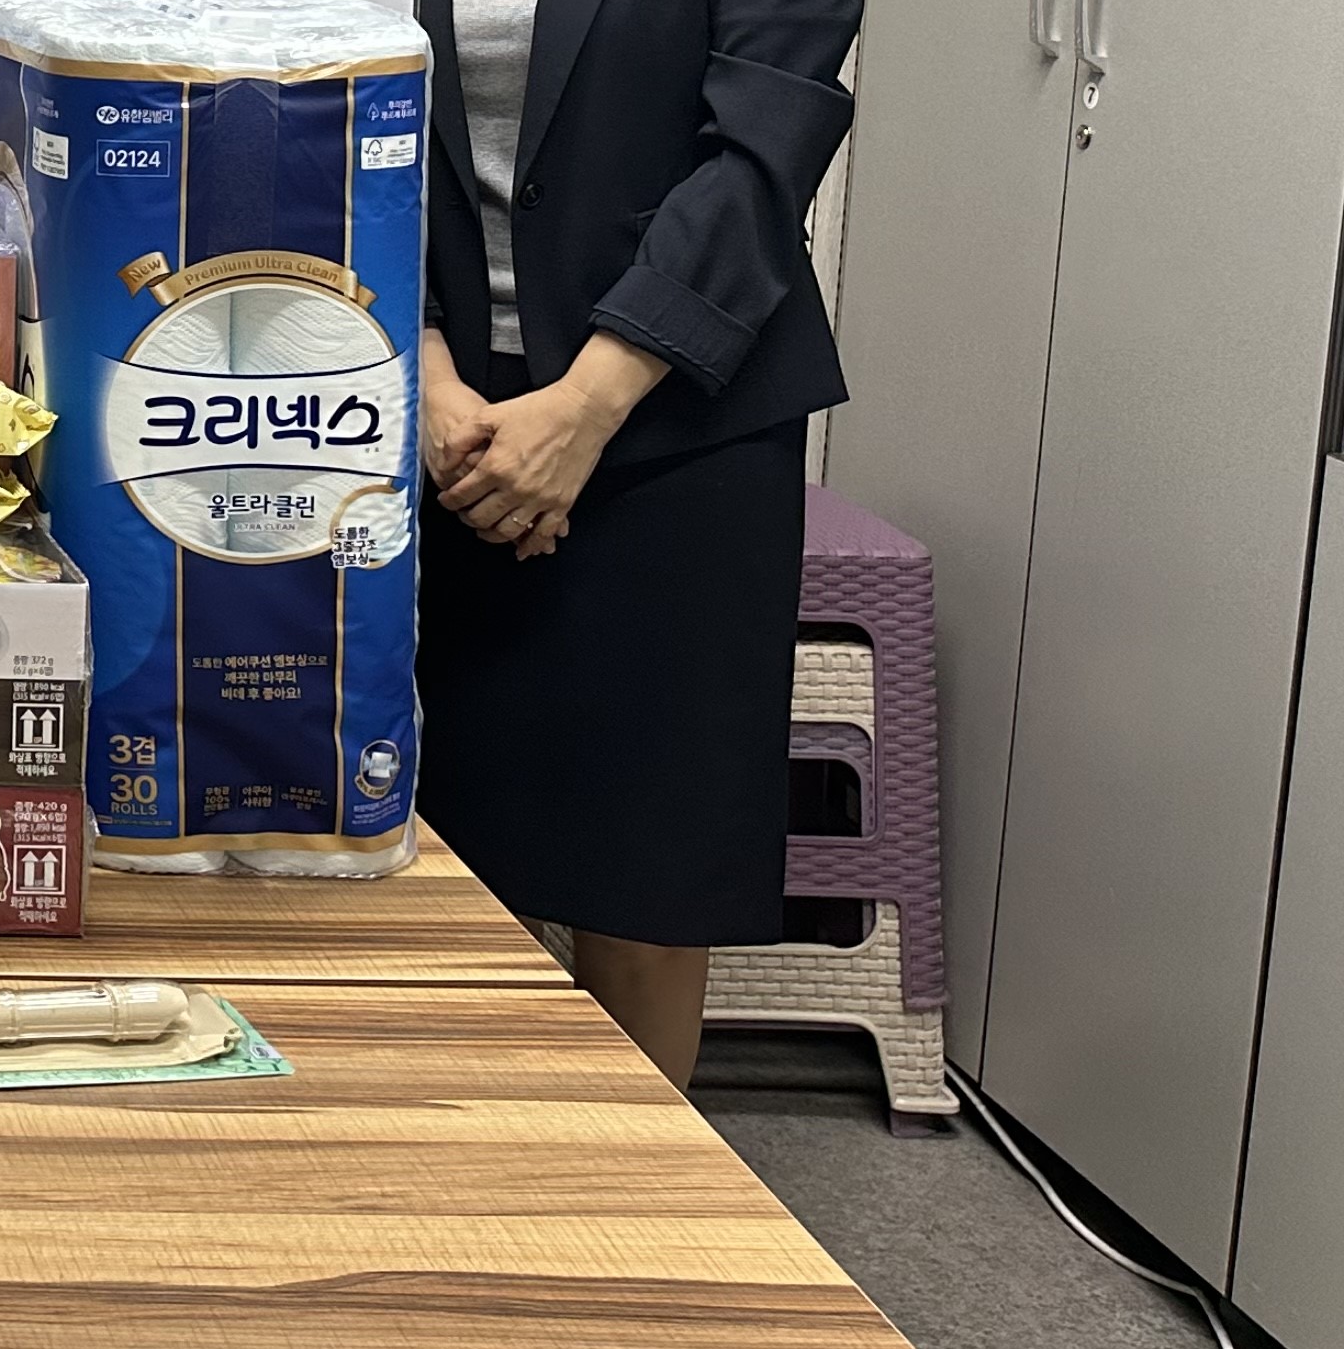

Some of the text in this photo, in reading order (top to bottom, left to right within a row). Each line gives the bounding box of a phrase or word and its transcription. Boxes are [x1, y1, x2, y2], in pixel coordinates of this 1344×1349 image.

[120, 108, 174, 124] 유한킴벌리
[103, 149, 162, 169] 02124
[128, 257, 163, 283] New
[183, 255, 339, 286] Premium Ultra Clean
[139, 394, 384, 450] 크리넥스
[207, 494, 316, 519] 울트라클린
[109, 734, 157, 766] 3겹
[110, 774, 159, 803] 30
[110, 803, 159, 816] ROLLS
